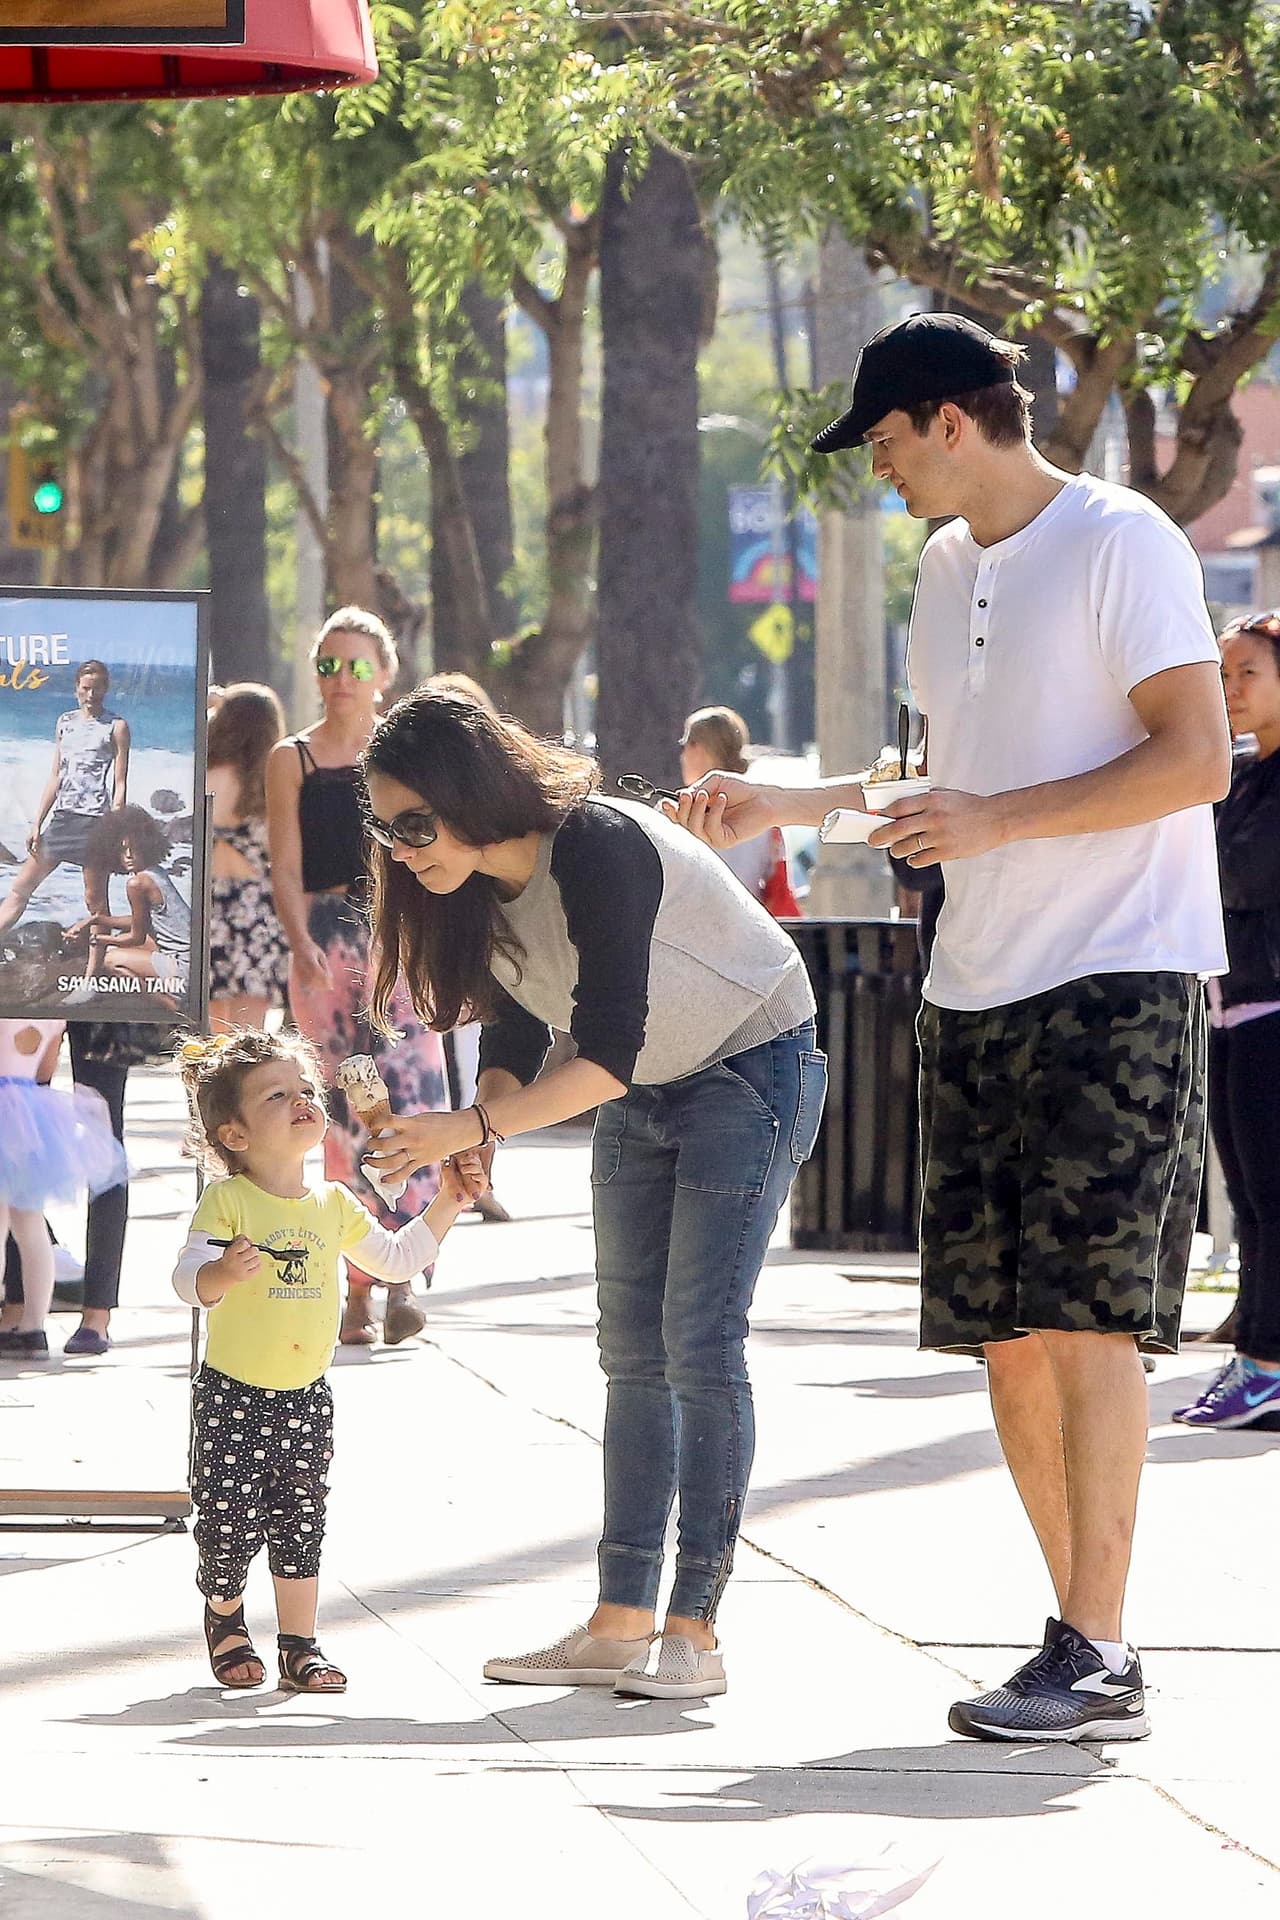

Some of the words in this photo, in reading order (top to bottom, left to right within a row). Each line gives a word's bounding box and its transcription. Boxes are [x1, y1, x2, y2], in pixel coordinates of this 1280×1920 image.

[57, 975, 141, 993] SAVASANA
[145, 977, 186, 994] TANK
[259, 1228, 295, 1247] ADDY'S
[298, 1229, 326, 1250] LITTLE
[267, 1287, 322, 1299] PRINCESS
